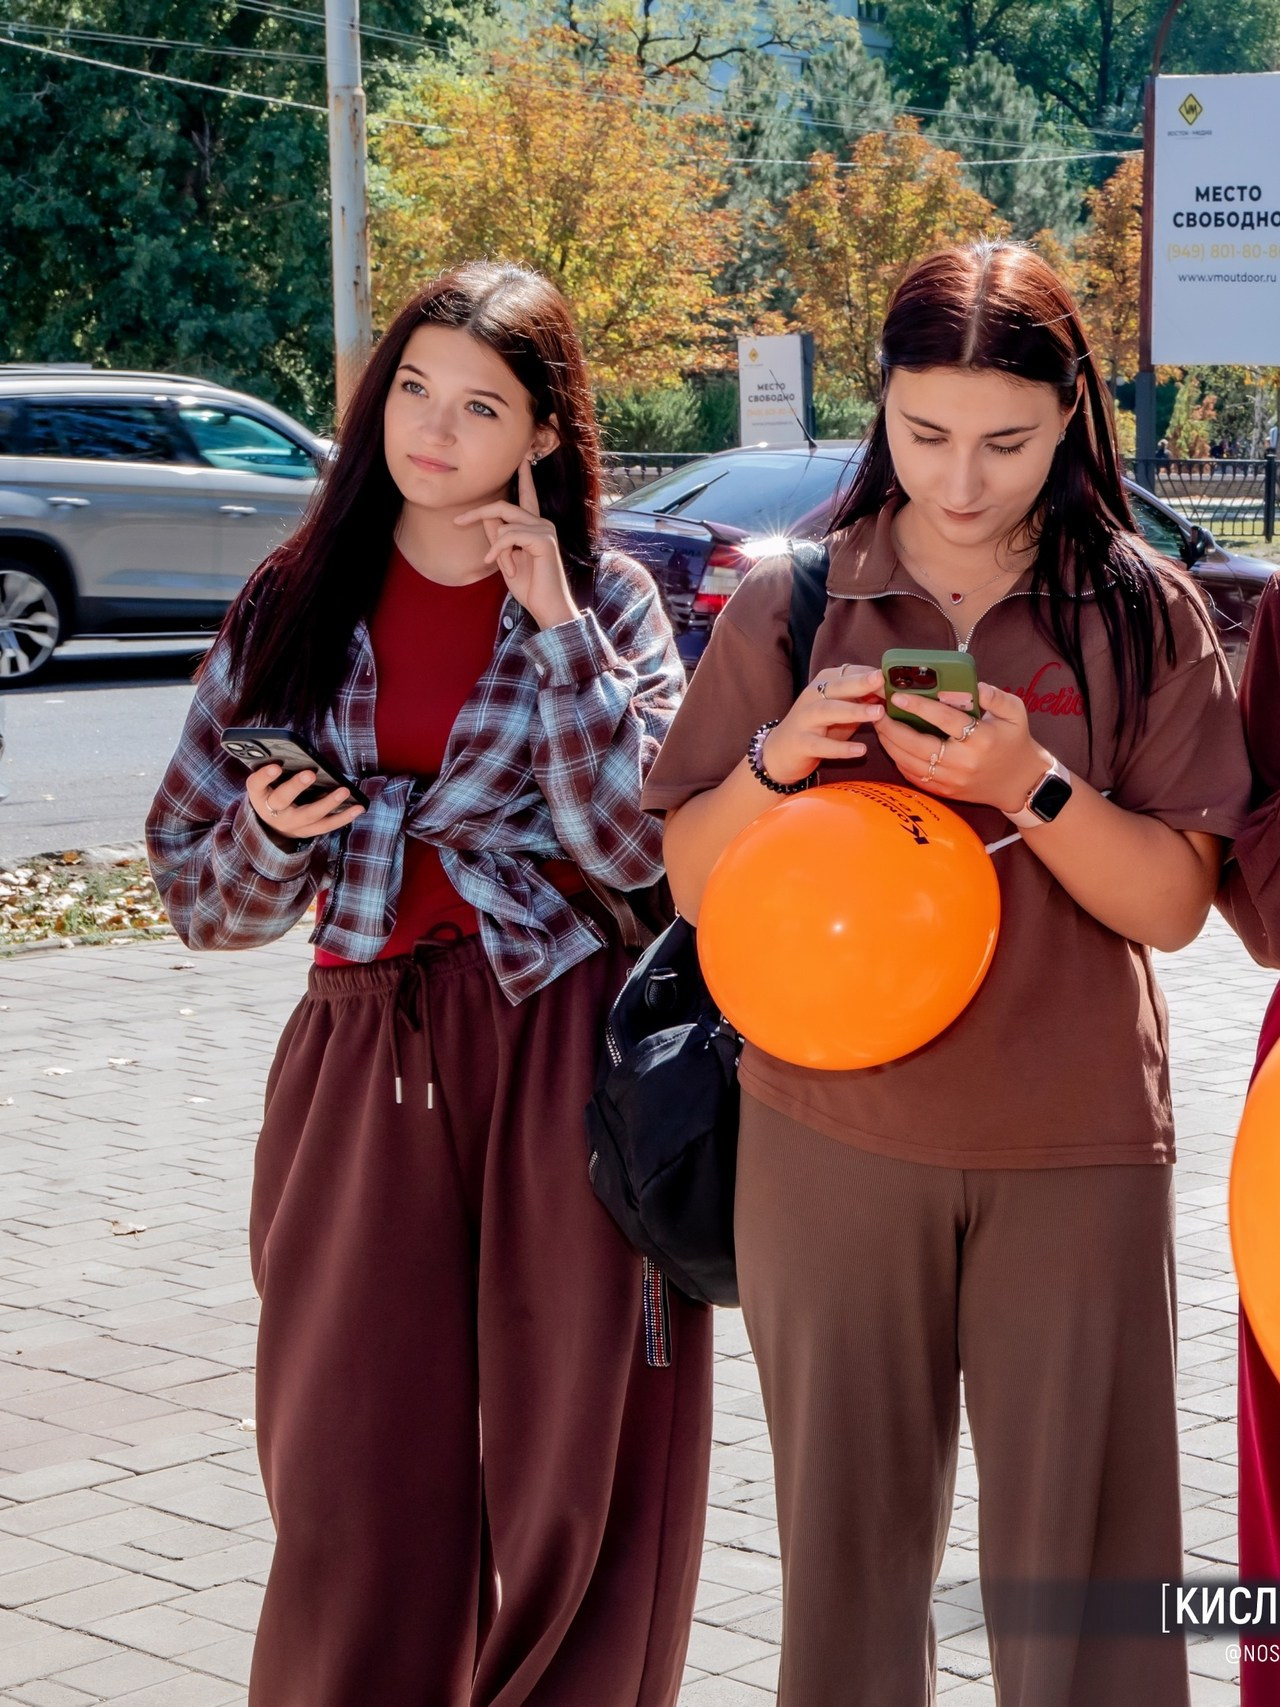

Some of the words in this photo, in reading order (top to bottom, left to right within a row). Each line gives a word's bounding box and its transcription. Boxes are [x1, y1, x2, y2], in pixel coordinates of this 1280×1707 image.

[1195, 186, 1262, 202] МЕСТО
[1167, 243, 1205, 262] (949)
[1178, 272, 1277, 283] www.vmoutdoor.ru
[757, 383, 786, 391] МЕСТО
[748, 393, 796, 403] СВОБОДНО
